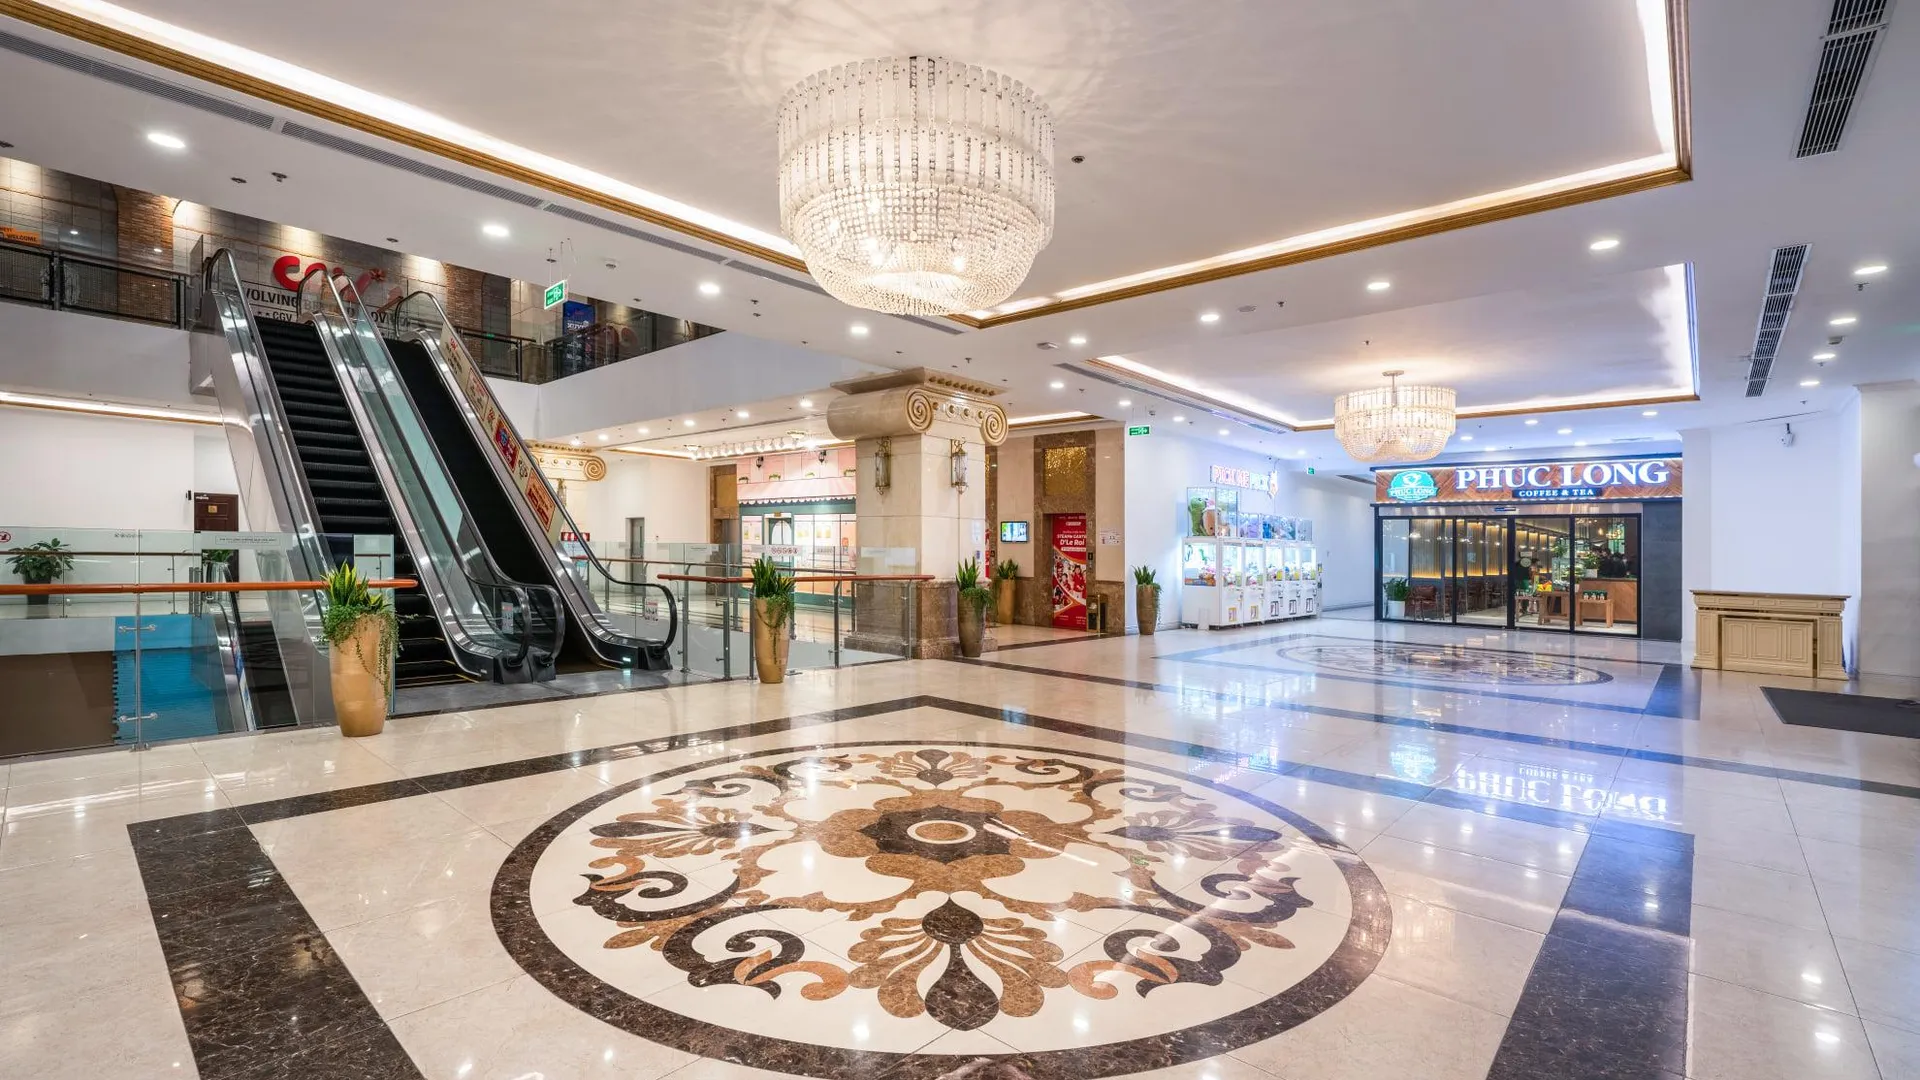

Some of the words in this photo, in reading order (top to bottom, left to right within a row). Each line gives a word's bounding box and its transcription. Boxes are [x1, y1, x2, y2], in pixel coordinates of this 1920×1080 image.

[272, 311, 293, 322] CGV
[1456, 465, 1550, 490] PHUC
[1560, 461, 1669, 486] LONG
[1519, 490, 1557, 498] COFFEE
[1561, 489, 1570, 497] &
[1572, 488, 1595, 496] TEA
[1074, 538, 1085, 546] Roi
